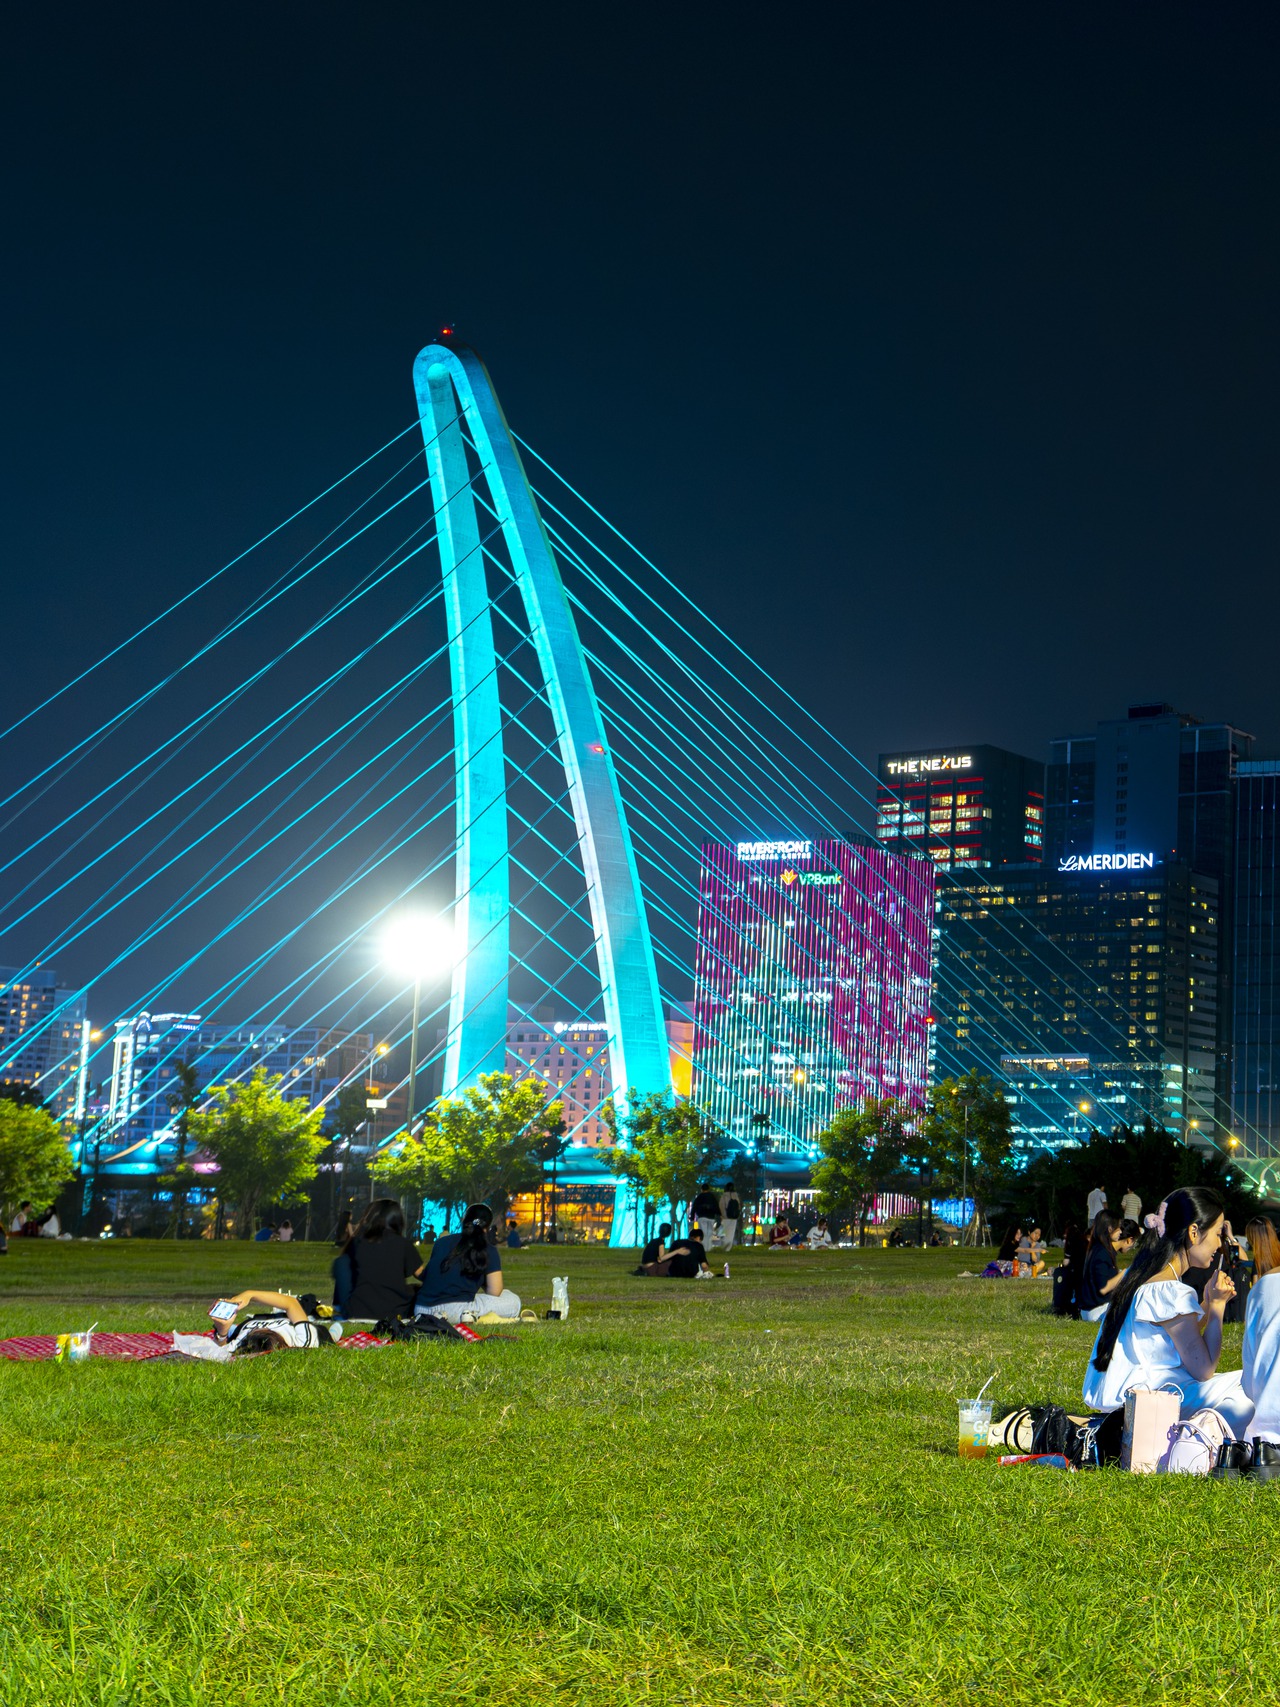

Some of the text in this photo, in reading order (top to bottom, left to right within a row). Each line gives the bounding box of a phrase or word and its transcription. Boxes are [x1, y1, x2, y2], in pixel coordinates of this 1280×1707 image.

[887, 756, 972, 774] THE NEXUS
[738, 841, 811, 854] RIVERFRONT
[799, 872, 842, 885] VPBank
[973, 1420, 989, 1433] GS
[972, 1433, 987, 1447] 25
